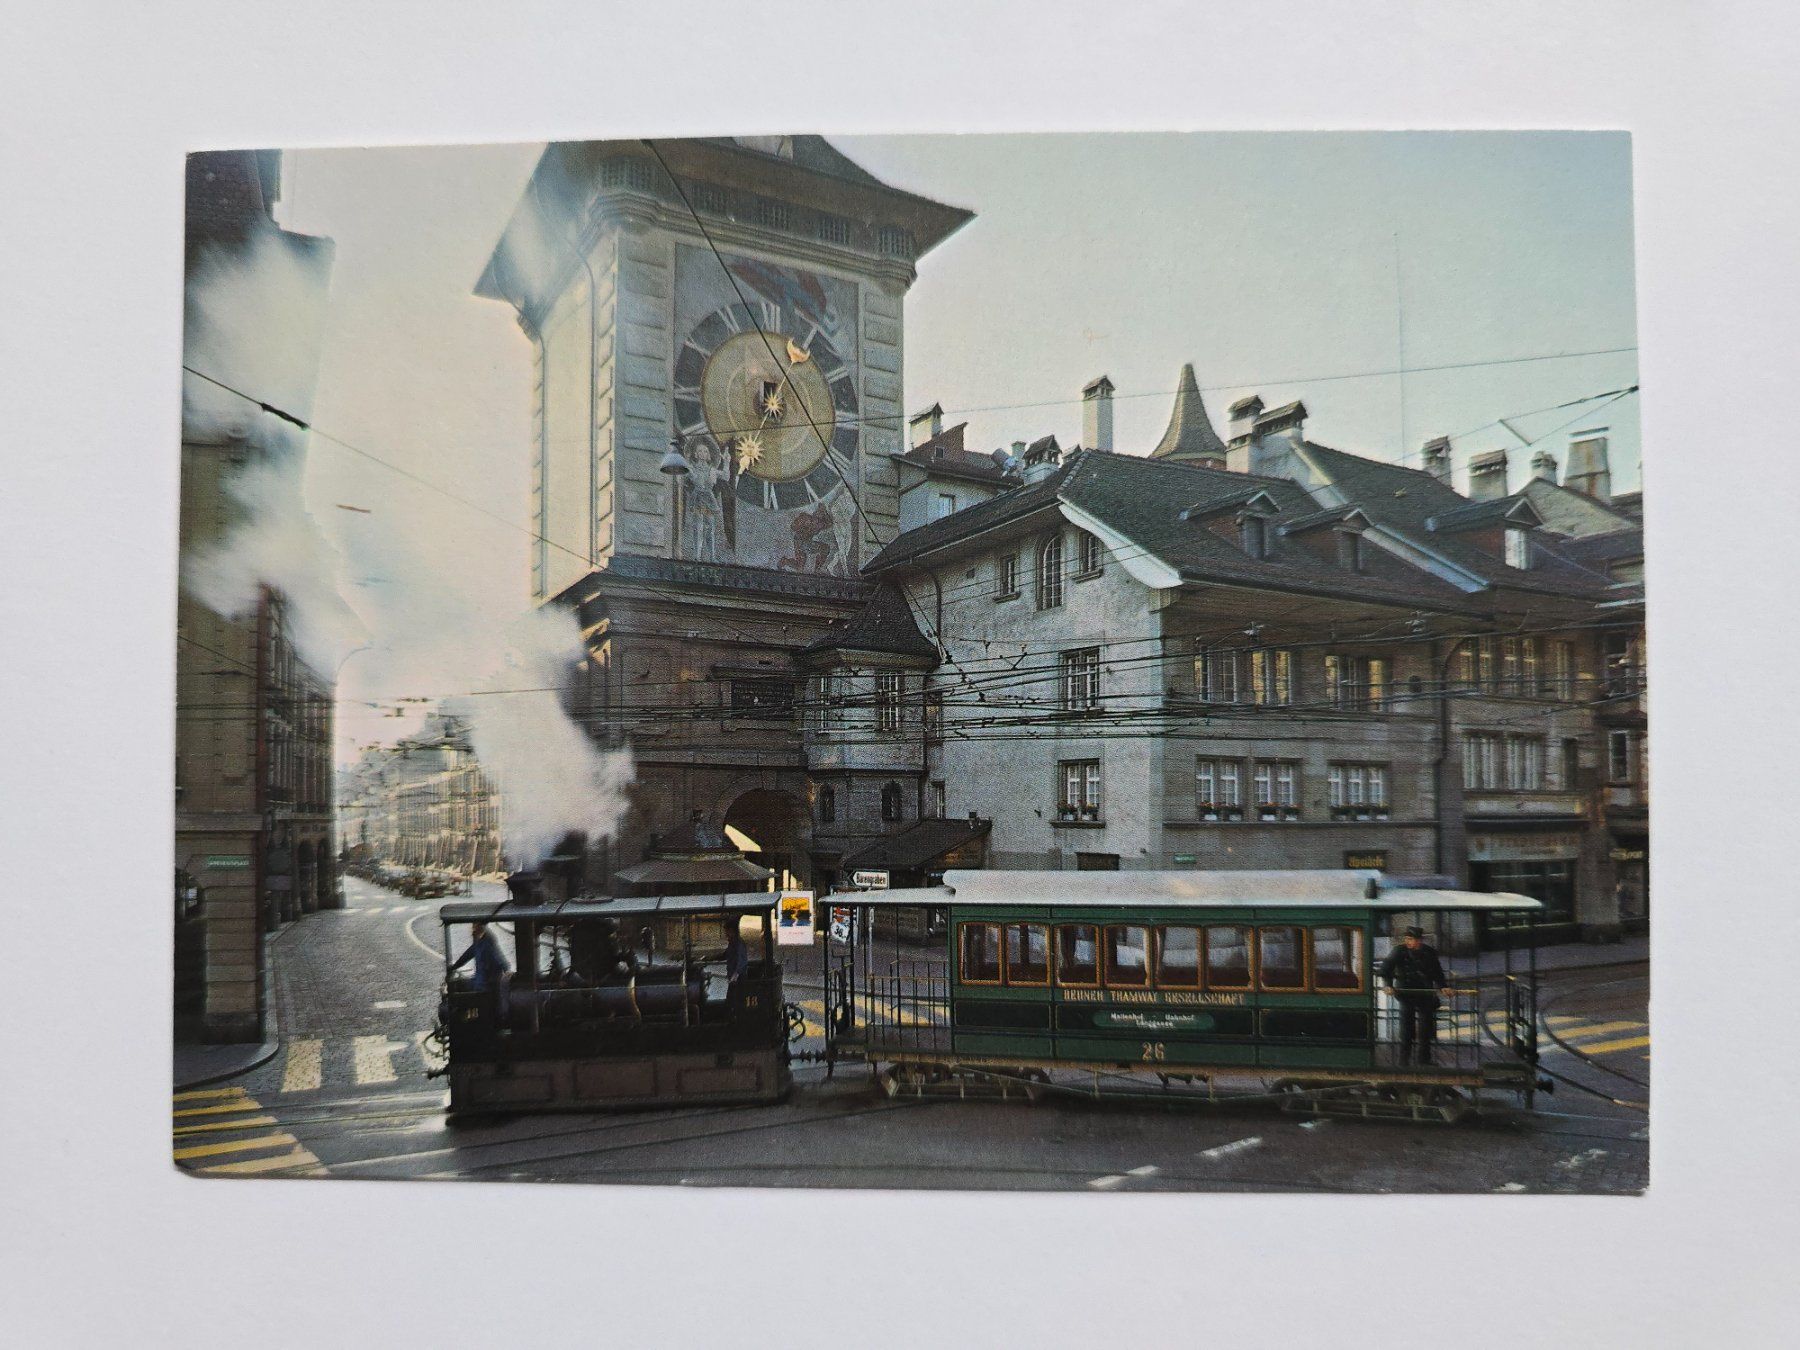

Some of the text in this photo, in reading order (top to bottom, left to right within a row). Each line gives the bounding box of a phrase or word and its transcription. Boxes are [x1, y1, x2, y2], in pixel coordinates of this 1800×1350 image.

[1063, 989, 1246, 1005] BERNER TRAMWAY GESELLSCHAFT
[1142, 1042, 1165, 1060] 26
